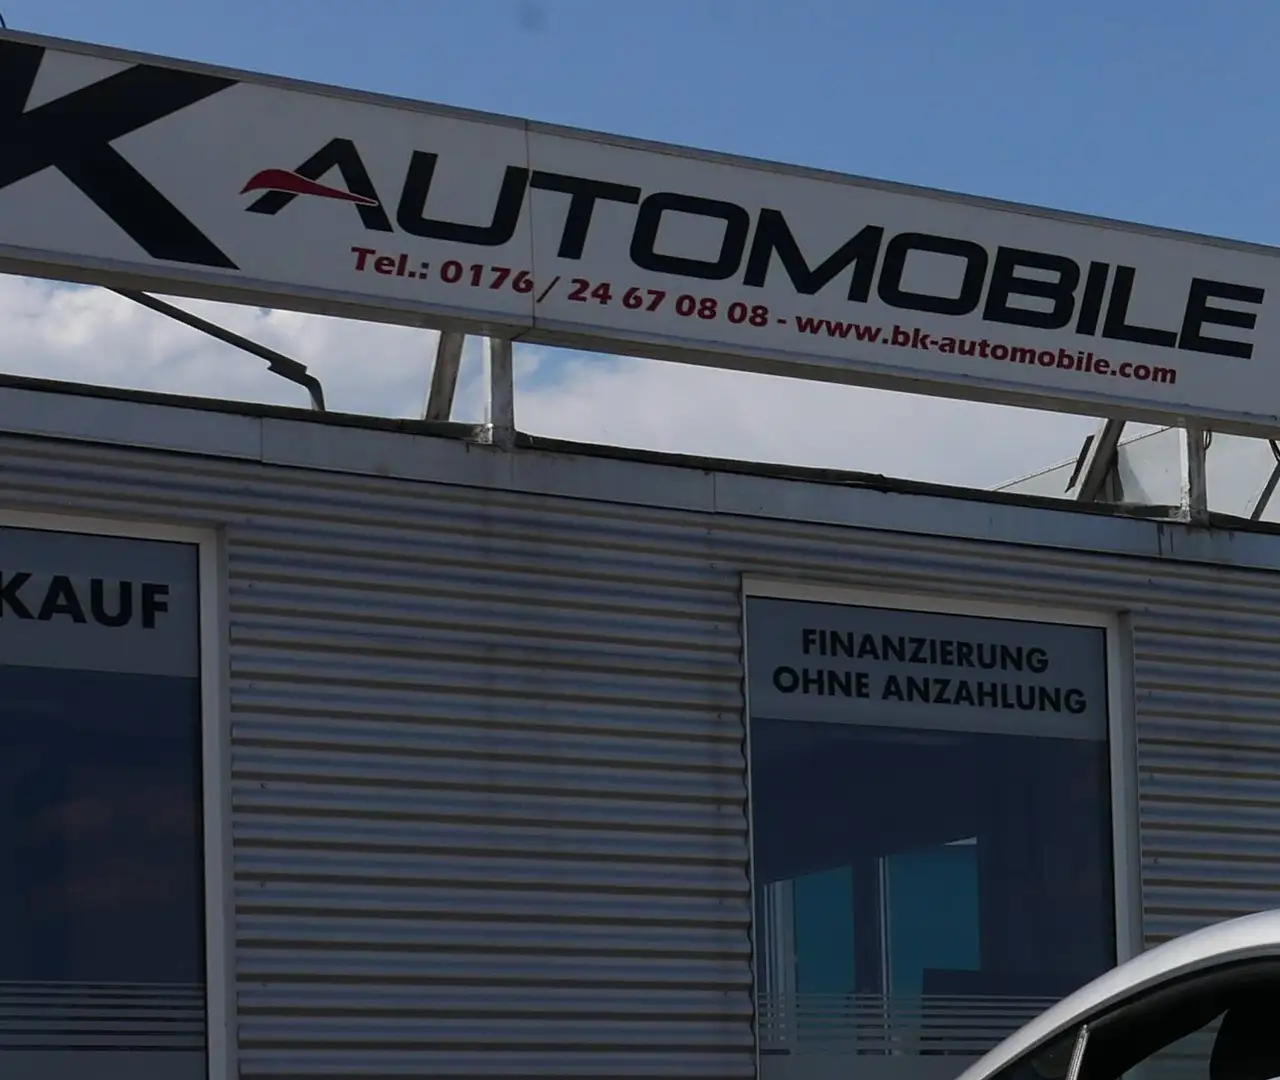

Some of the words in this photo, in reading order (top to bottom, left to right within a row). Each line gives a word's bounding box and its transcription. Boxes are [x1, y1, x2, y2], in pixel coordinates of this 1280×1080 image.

[240, 137, 1266, 361] AUTOMOBILE
[351, 246, 430, 280] Tel.:
[440, 259, 536, 294] 0176
[568, 278, 614, 305] 24
[622, 287, 667, 313] 67
[675, 294, 718, 320] 08
[727, 302, 769, 327] 08
[796, 315, 1178, 384] www.bk-automobile.com
[0, 571, 170, 629] KAUF
[801, 628, 1049, 673] FINANZIERUNG
[772, 665, 870, 699] OHNE
[882, 675, 1087, 715] ANZAHLUNG
